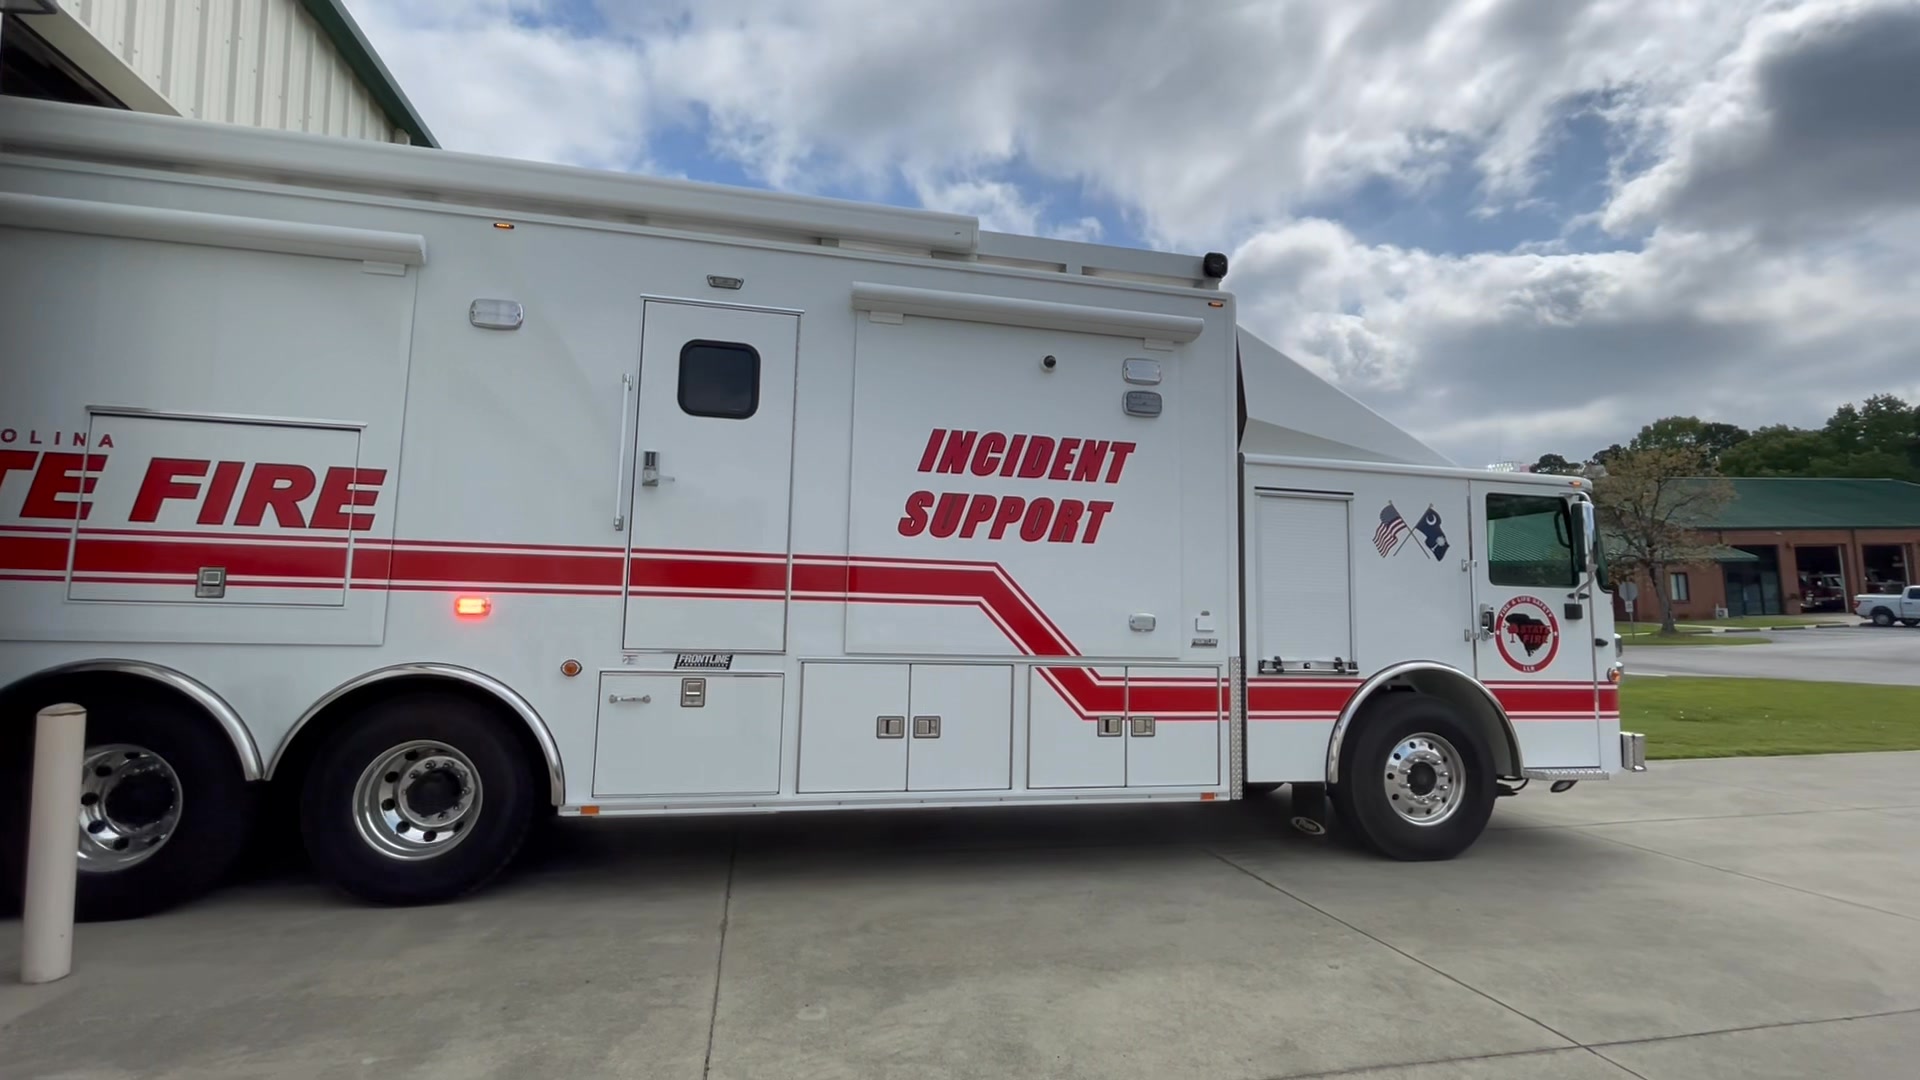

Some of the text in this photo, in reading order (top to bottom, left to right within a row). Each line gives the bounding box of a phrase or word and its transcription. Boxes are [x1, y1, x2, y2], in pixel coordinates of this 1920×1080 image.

[0, 428, 114, 448] OLINA
[917, 428, 1137, 484] INCIDENT
[128, 457, 387, 531] FIRE
[897, 490, 1114, 544] SUPPORT
[1520, 625, 1550, 634] STATE
[1522, 633, 1548, 644] FIRE
[679, 654, 731, 663] FRONTLINE
